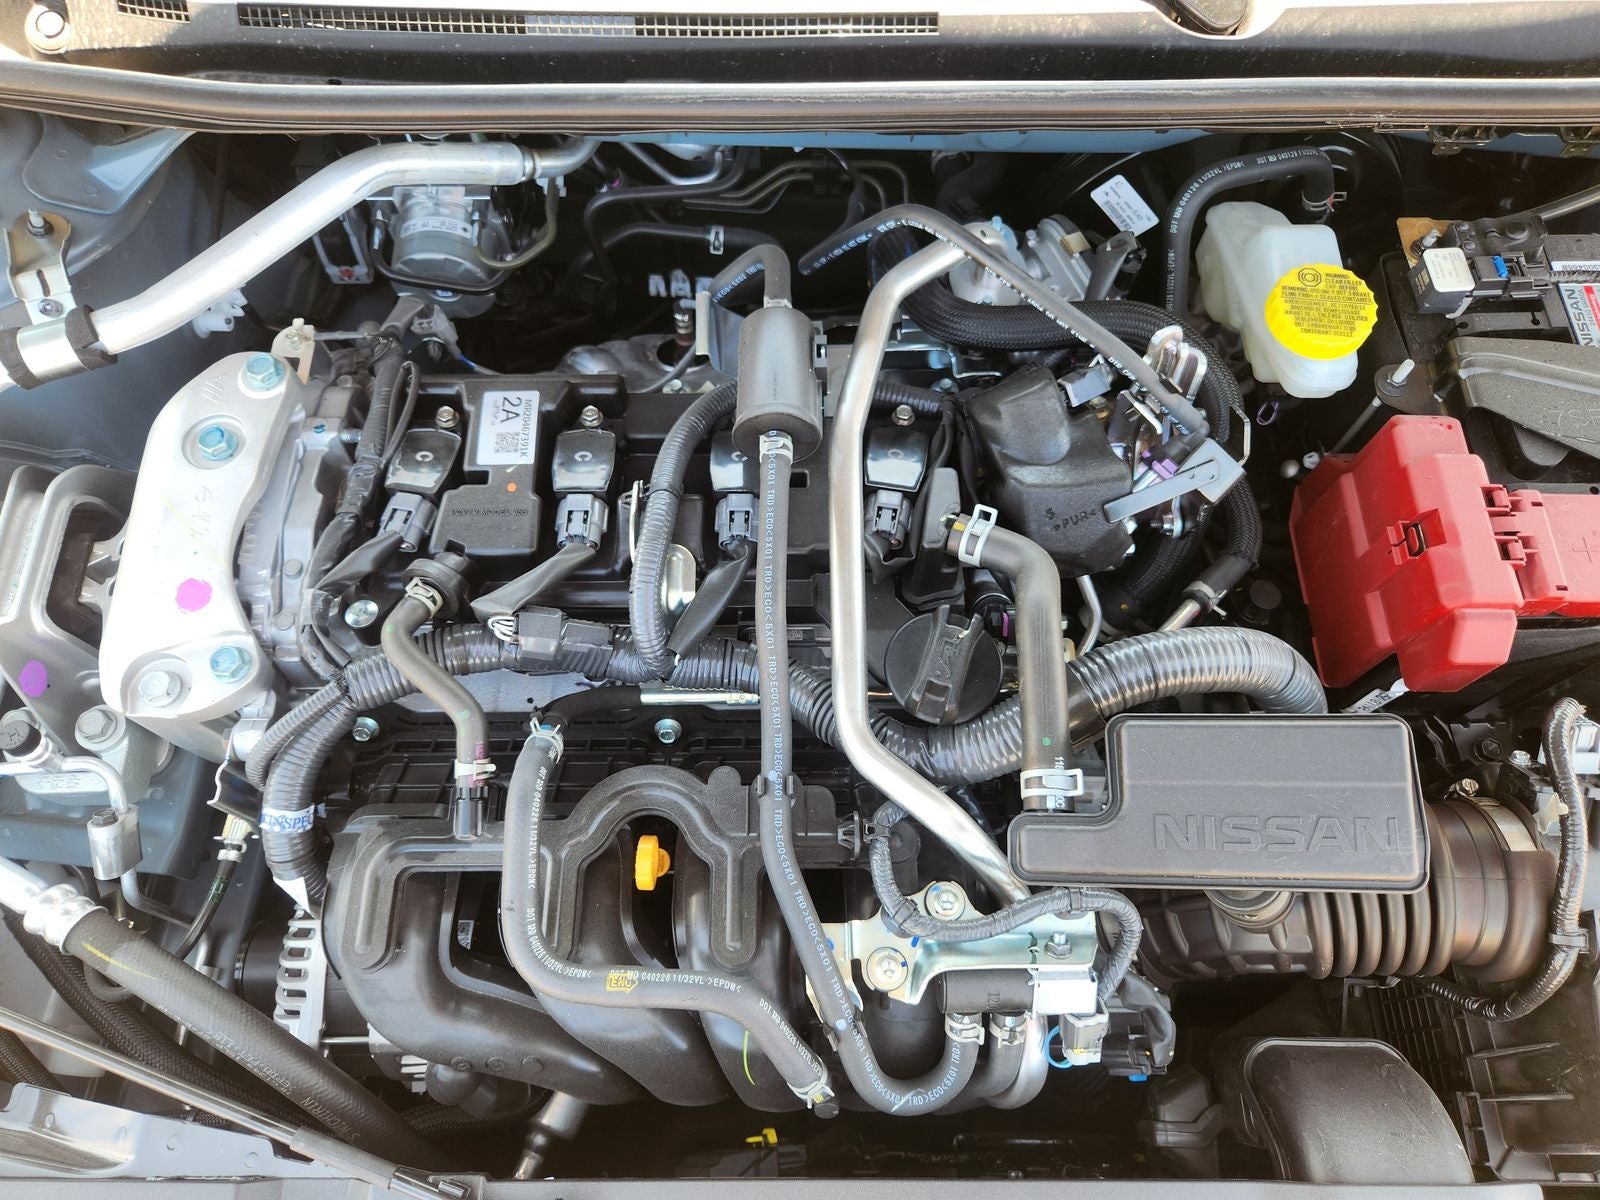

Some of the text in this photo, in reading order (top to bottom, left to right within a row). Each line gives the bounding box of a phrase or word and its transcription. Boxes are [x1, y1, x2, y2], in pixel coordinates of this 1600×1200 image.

[1565, 288, 1598, 347] NISSAN
[500, 396, 522, 423] 2A
[1153, 814, 1400, 853] NISSAN
[641, 971, 671, 983] 040226
